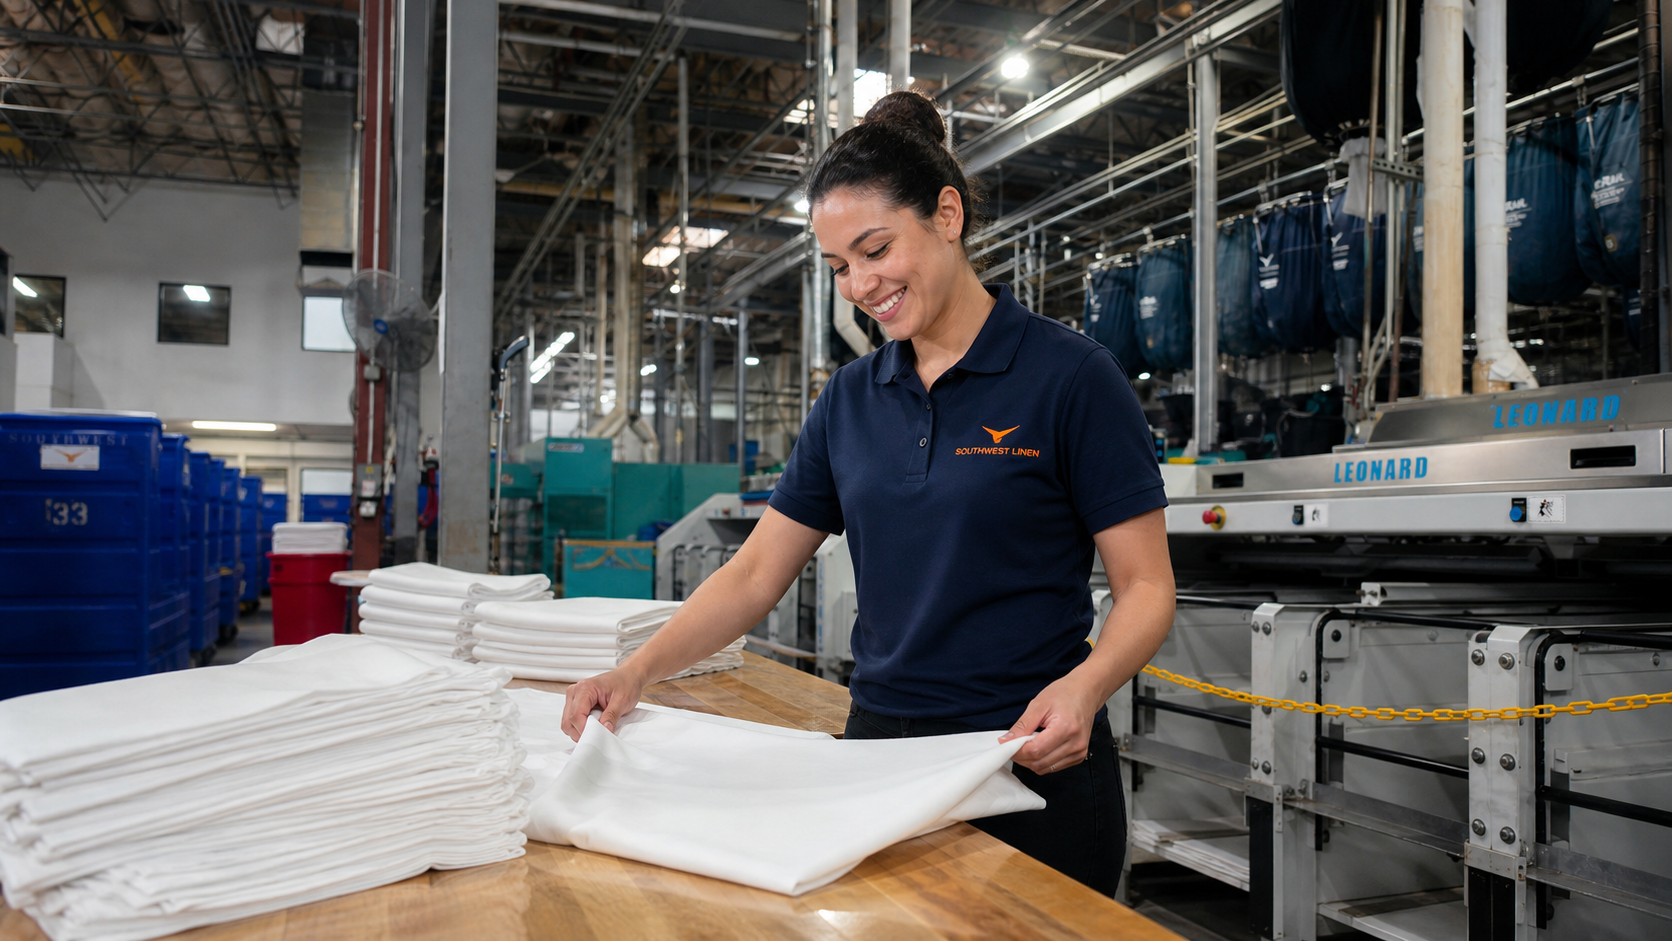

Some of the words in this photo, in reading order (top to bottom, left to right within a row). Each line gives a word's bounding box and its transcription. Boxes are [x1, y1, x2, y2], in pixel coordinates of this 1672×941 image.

[1493, 395, 1620, 428] LEONARD
[955, 447, 1010, 455] SOUTHWEST
[1011, 448, 1040, 457] LINEN
[1334, 457, 1428, 483] LEONARD
